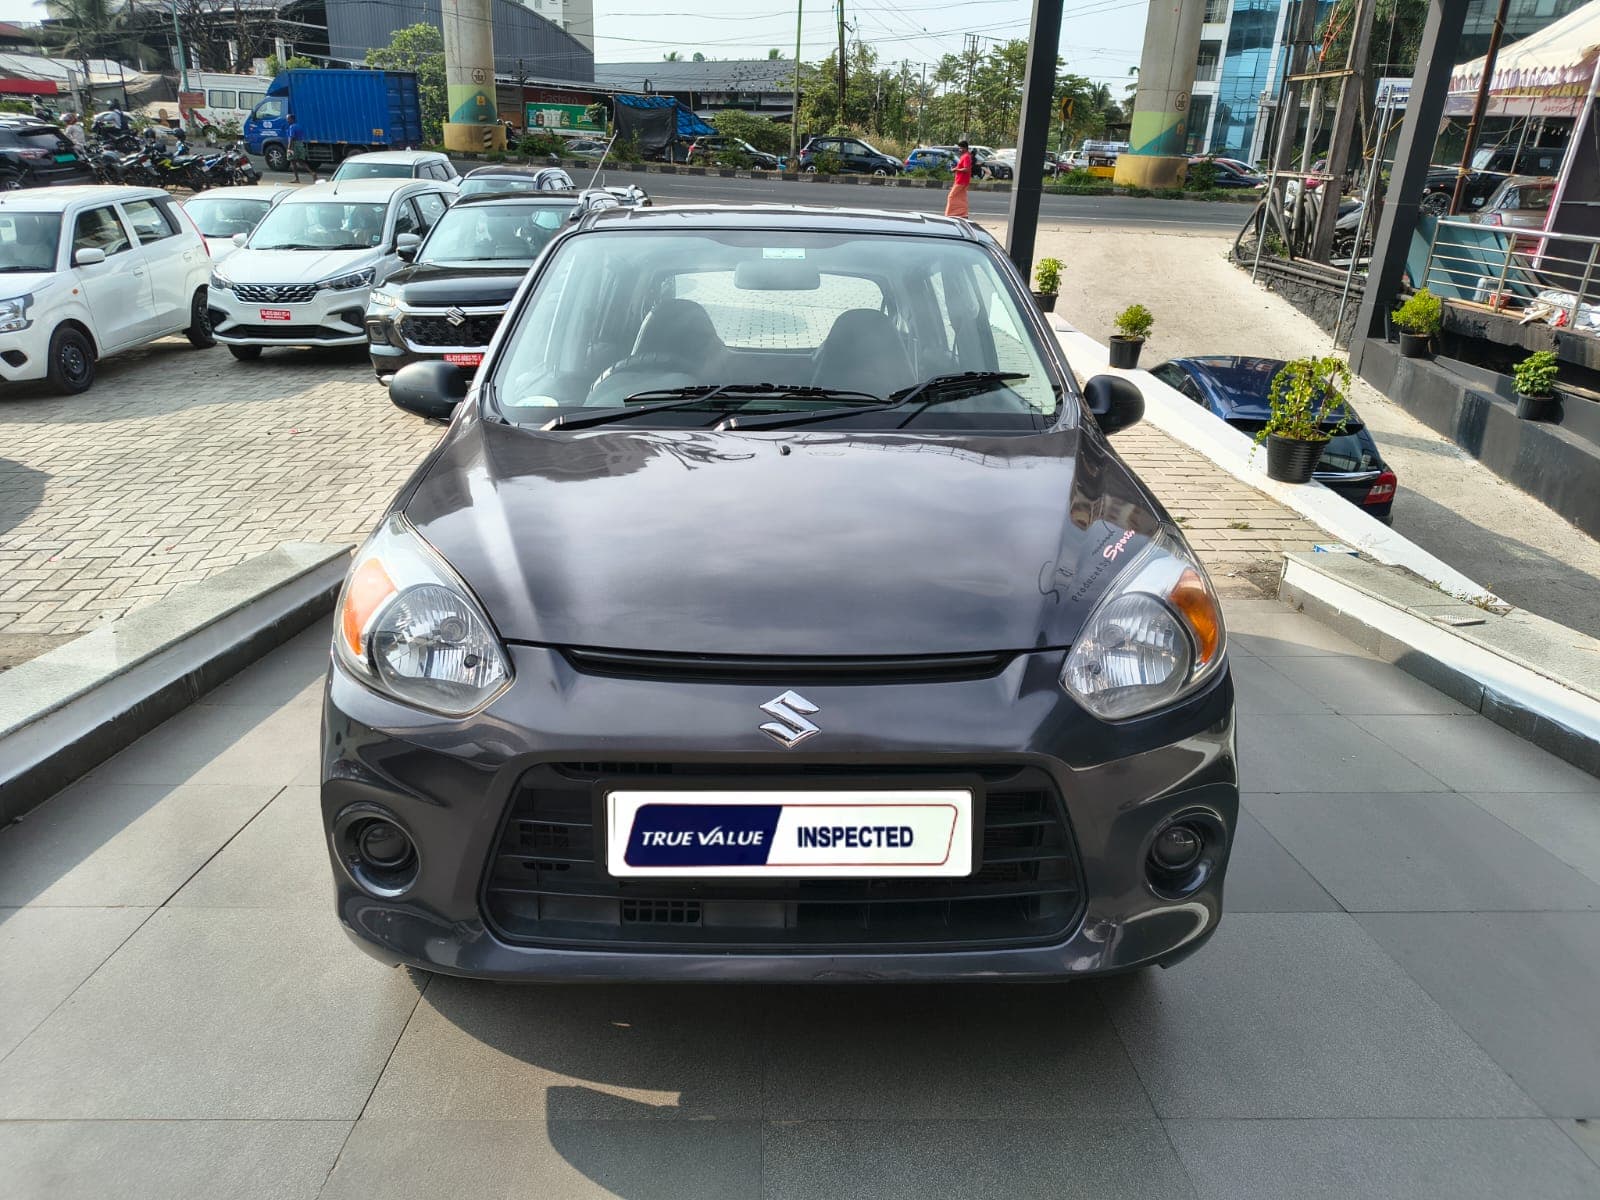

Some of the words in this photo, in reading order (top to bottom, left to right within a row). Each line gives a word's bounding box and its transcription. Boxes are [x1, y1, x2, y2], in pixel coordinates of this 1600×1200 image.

[642, 831, 693, 846] TRUE
[698, 826, 763, 846] VALUE
[797, 827, 913, 848] INSPECTED
